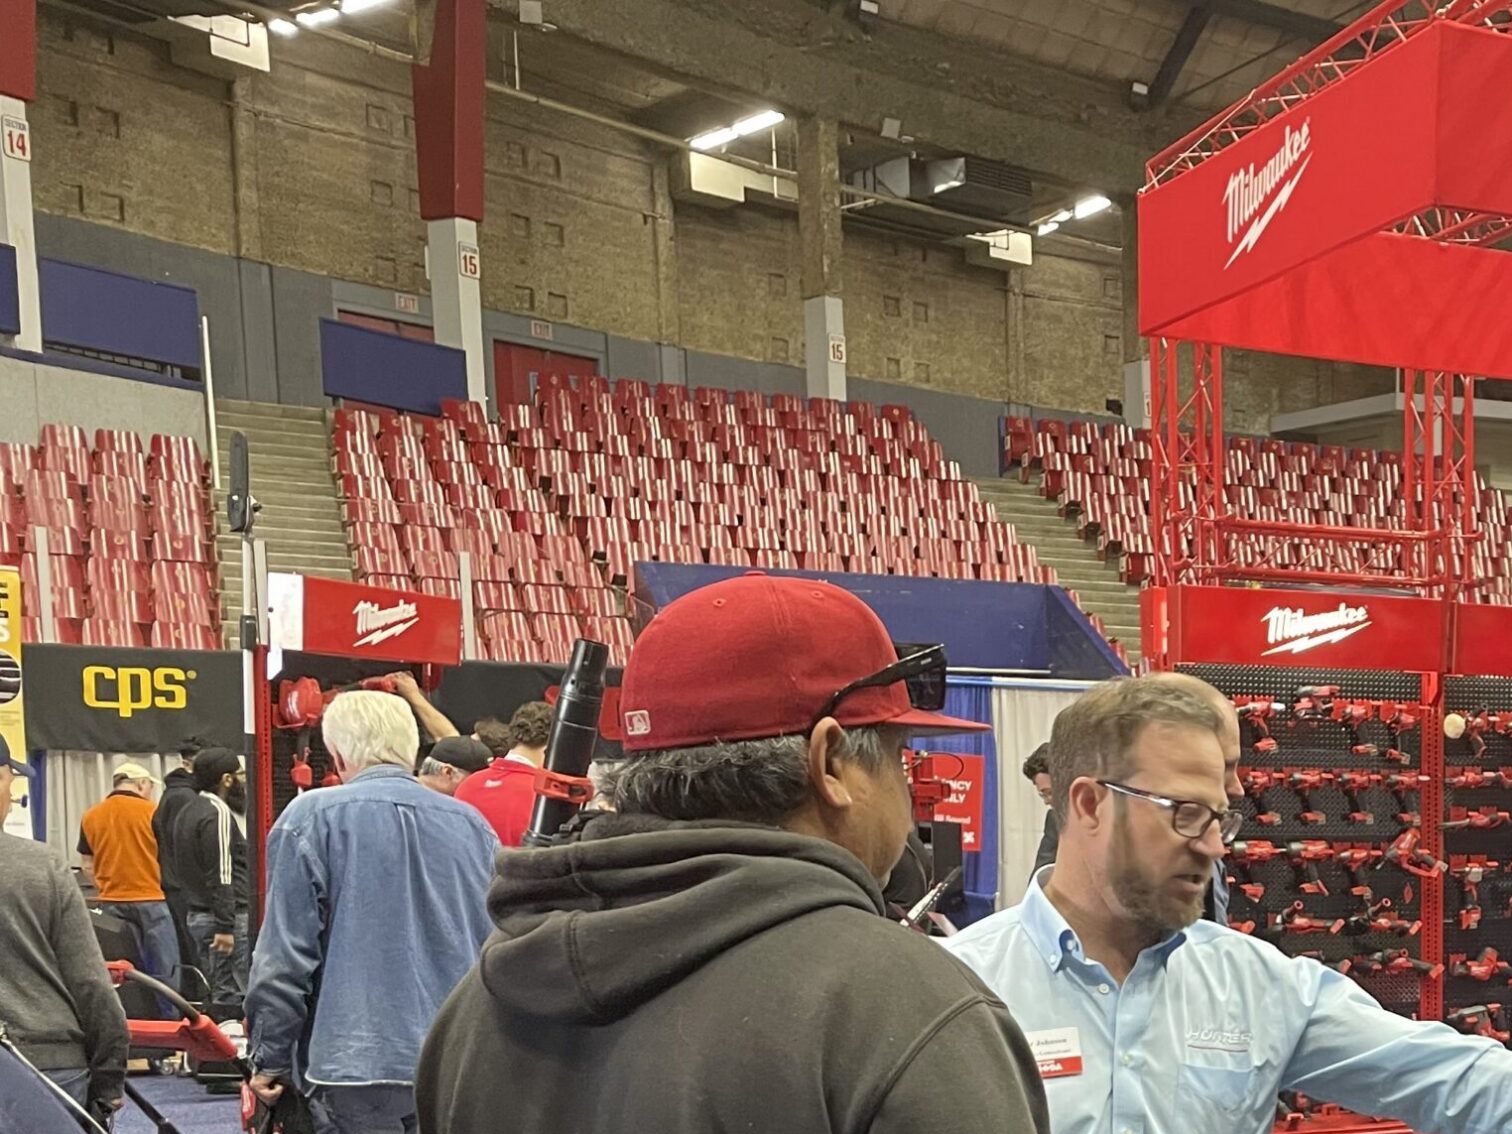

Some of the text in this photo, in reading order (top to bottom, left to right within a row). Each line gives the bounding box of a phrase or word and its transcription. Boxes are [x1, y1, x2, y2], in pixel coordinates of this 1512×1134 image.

[7, 130, 26, 156] 14
[1222, 122, 1311, 243] Milwaukee
[462, 254, 477, 275] 15
[832, 344, 843, 360] 15
[1261, 602, 1368, 644] Milwaukee
